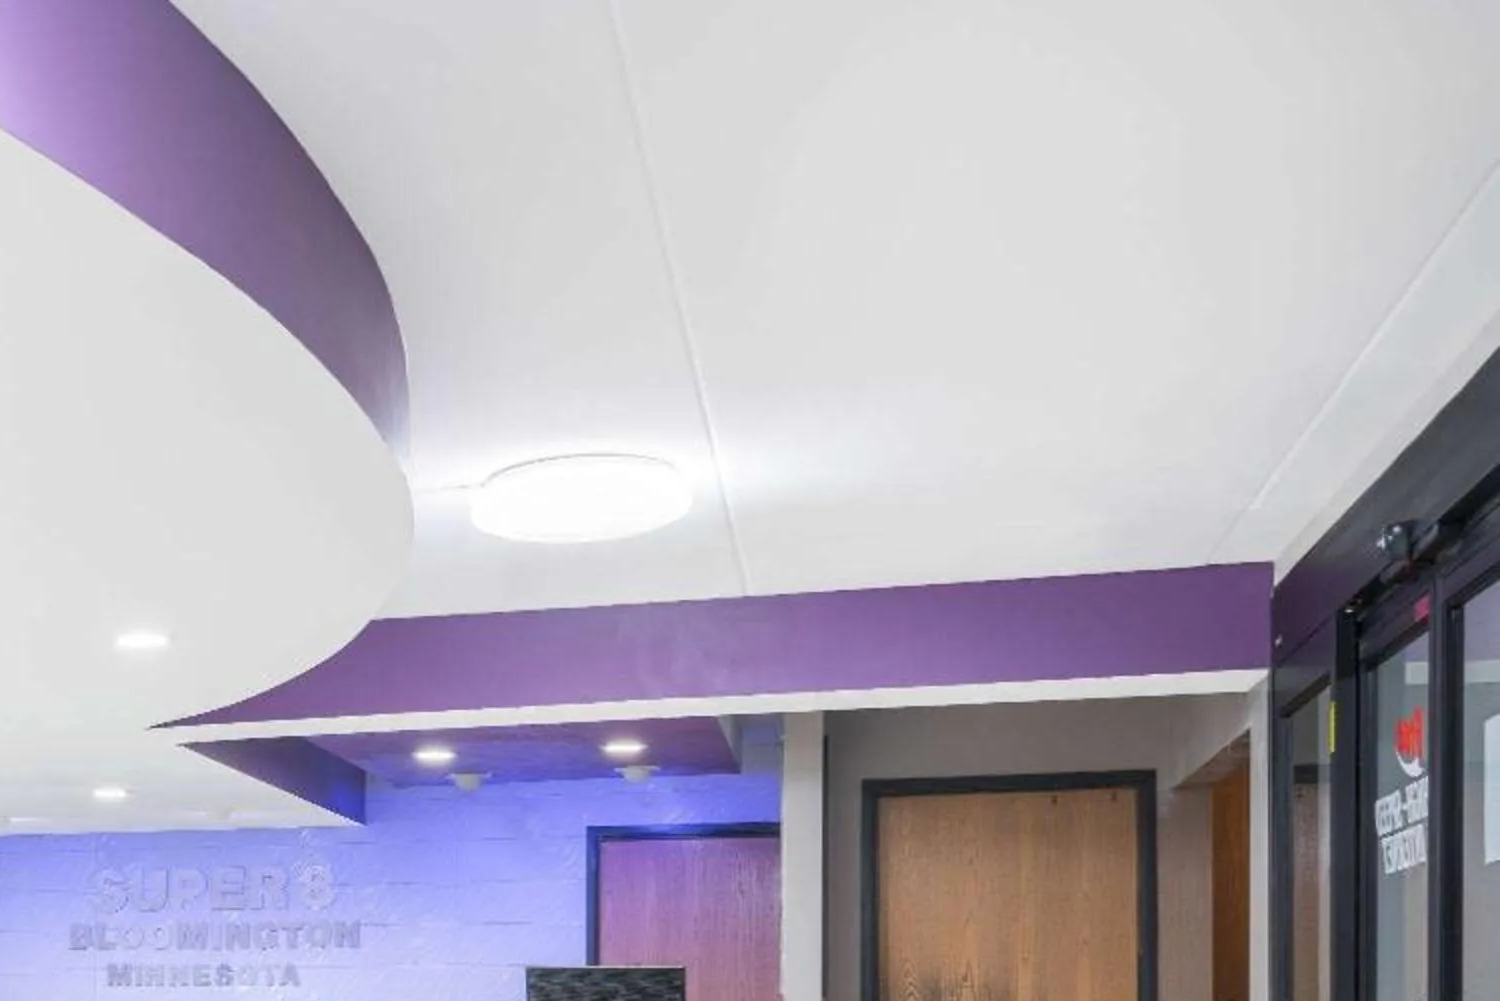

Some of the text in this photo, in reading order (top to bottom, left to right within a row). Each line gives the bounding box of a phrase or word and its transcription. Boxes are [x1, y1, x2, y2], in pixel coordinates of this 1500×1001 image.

[90, 858, 336, 913] SUPER 8
[68, 920, 362, 951] BLOOMINGTON
[107, 963, 301, 988] MINNESOTA
